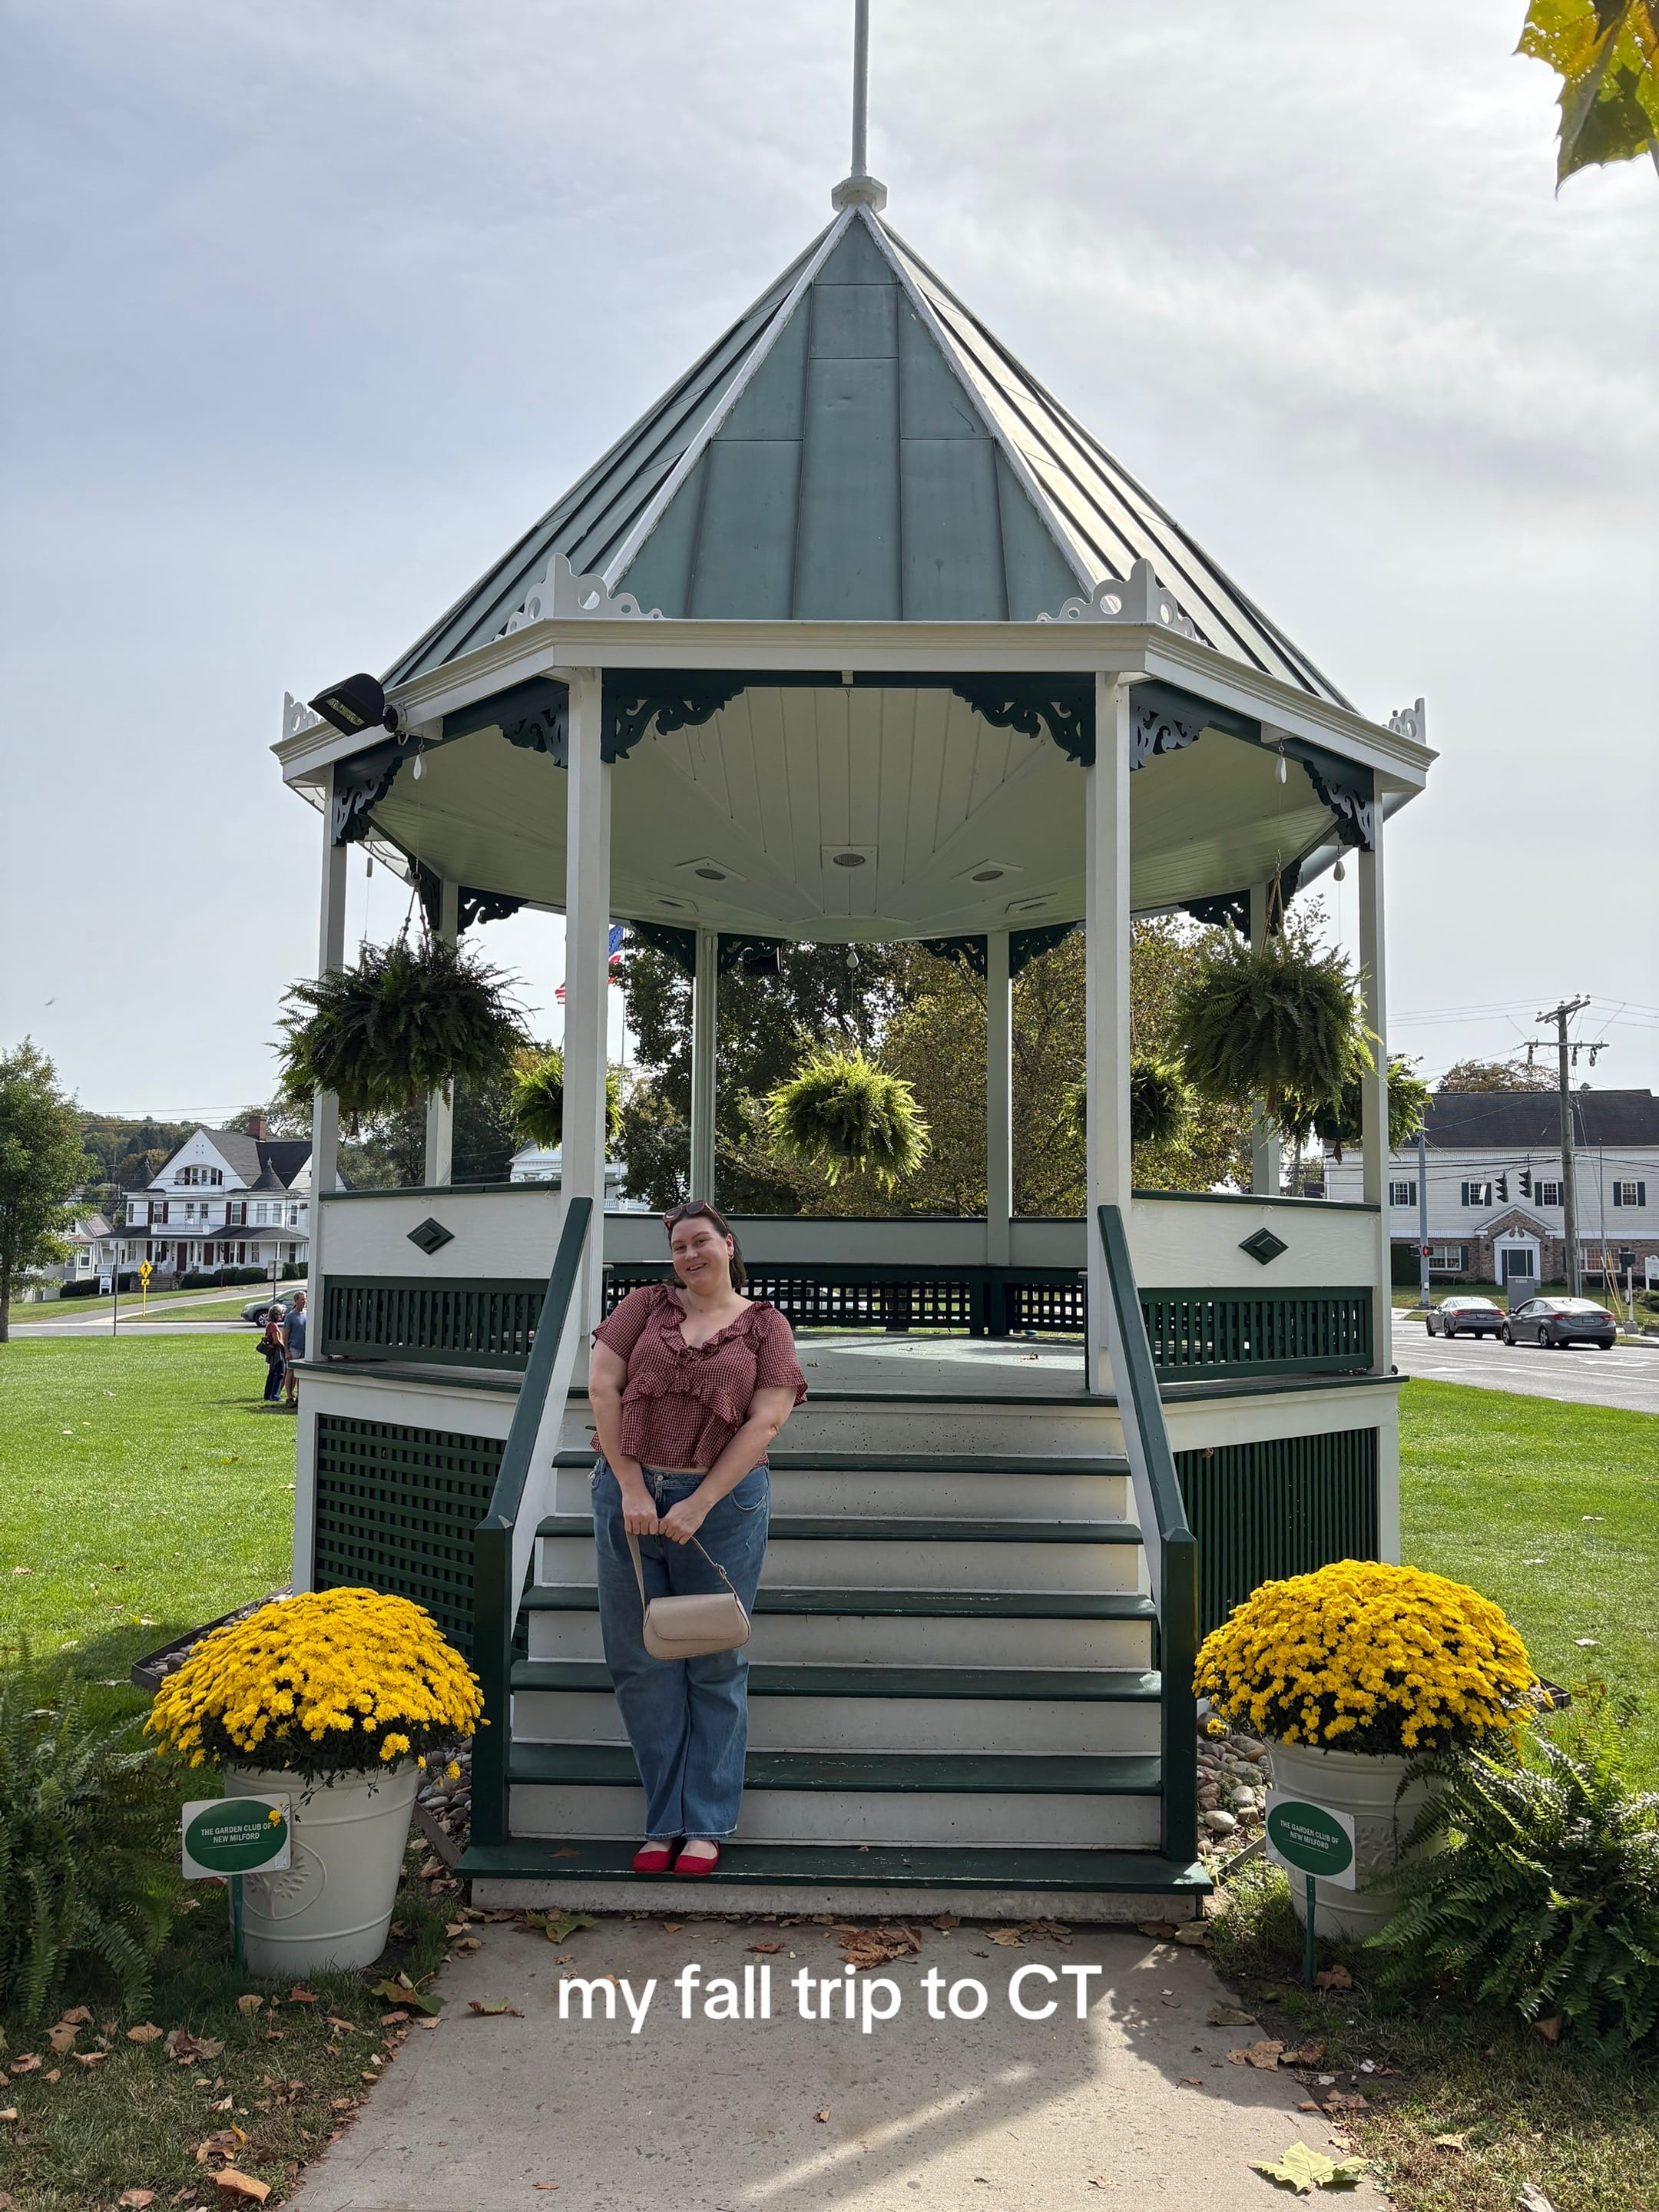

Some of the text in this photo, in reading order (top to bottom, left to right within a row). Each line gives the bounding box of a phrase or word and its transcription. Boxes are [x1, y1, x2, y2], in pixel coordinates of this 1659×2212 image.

[200, 1828, 214, 1836] THE
[215, 1825, 243, 1834] GARDEN
[243, 1823, 262, 1832] CLUB
[1280, 1820, 1291, 1830] THE
[1292, 1823, 1315, 1837] GARDEN
[1315, 1831, 1331, 1842] CLUB
[213, 1833, 260, 1844] NEW MILFORD
[1290, 1831, 1330, 1849] NEW MILFORD
